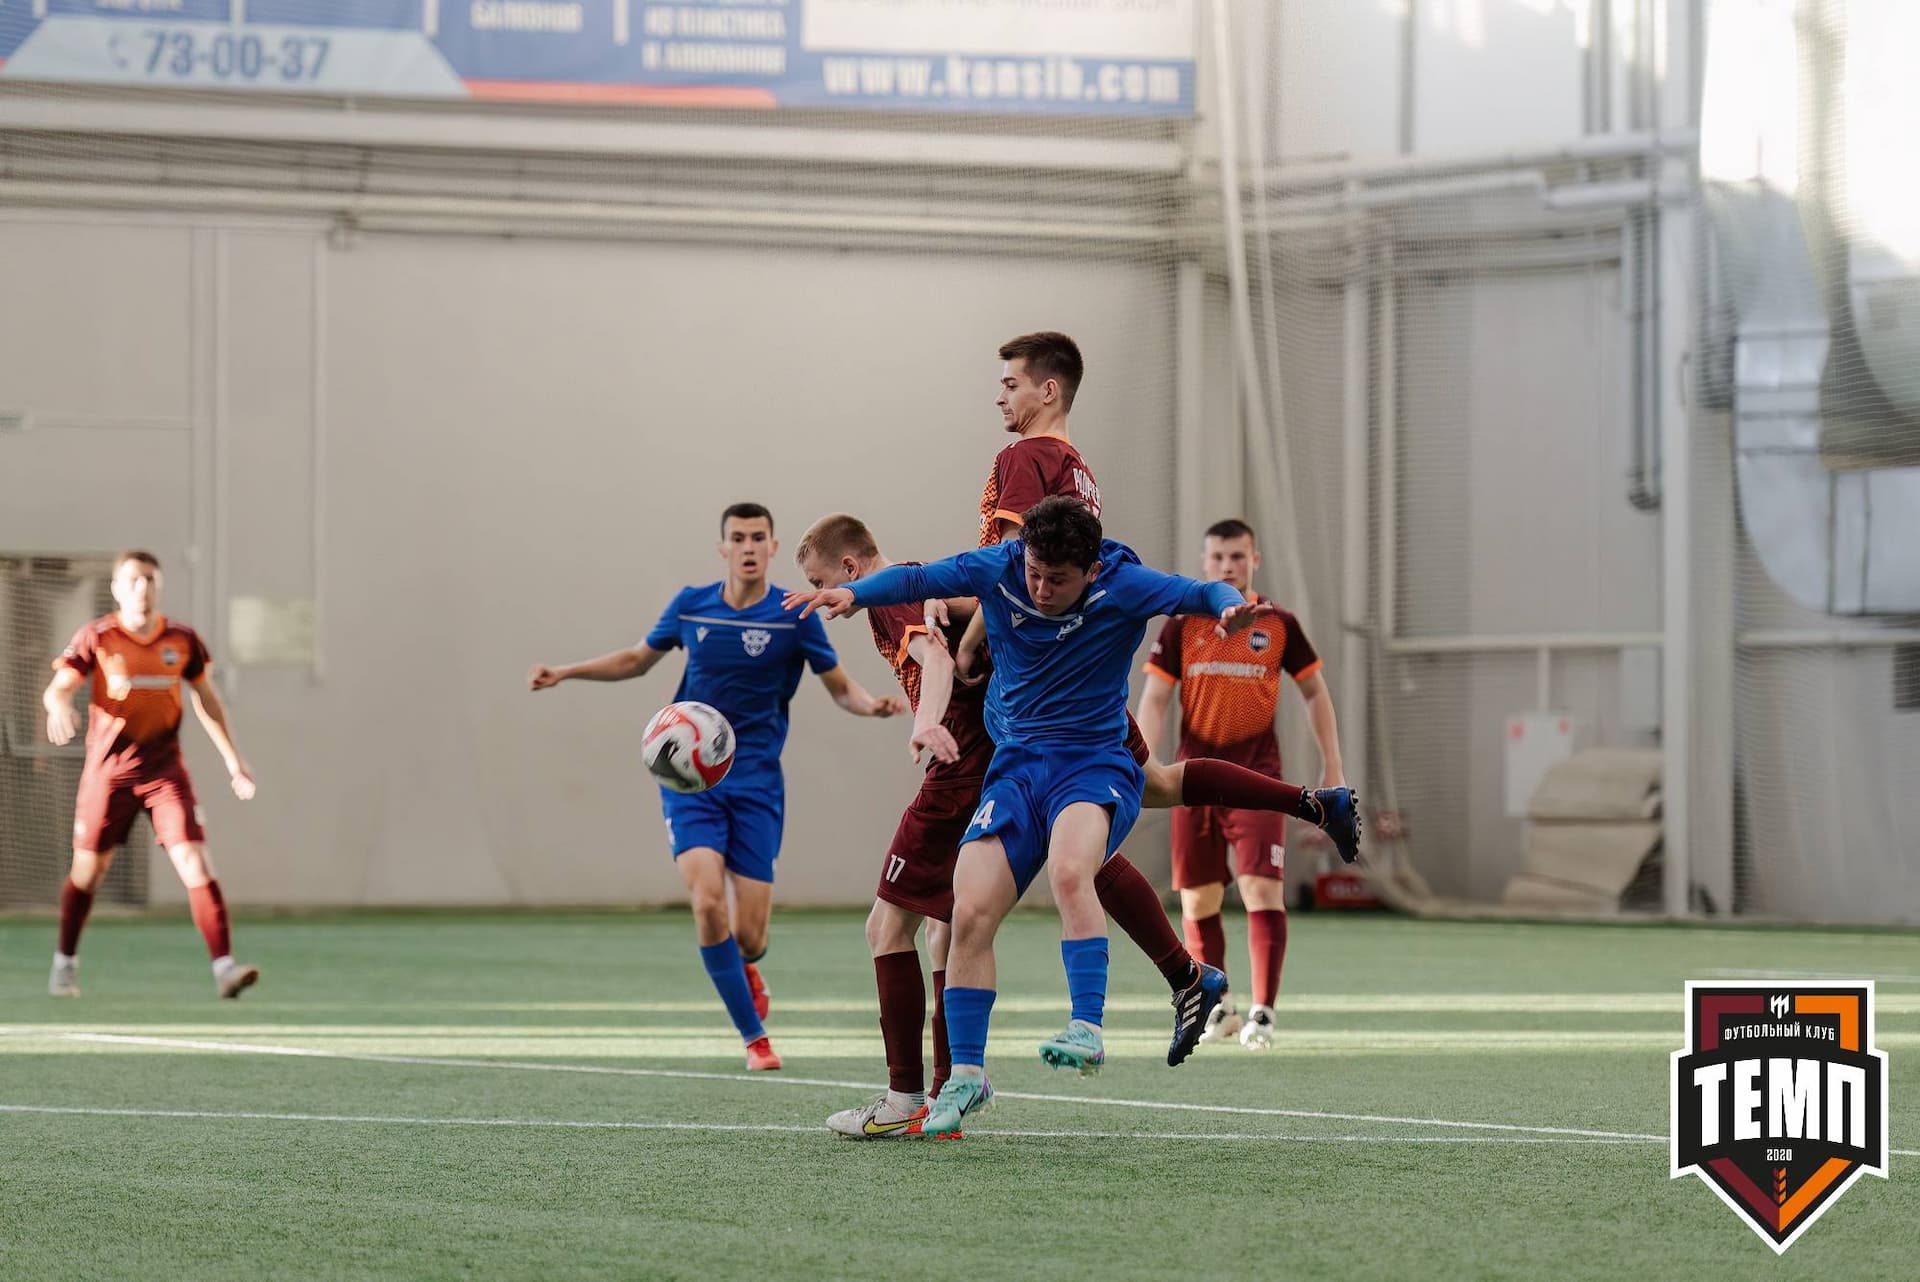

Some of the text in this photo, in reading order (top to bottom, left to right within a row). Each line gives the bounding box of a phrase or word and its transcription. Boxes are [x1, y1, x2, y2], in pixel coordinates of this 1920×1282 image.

[143, 30, 331, 80] 73-00-37
[822, 54, 1181, 102] www.konsib.com
[885, 854, 906, 883] 17
